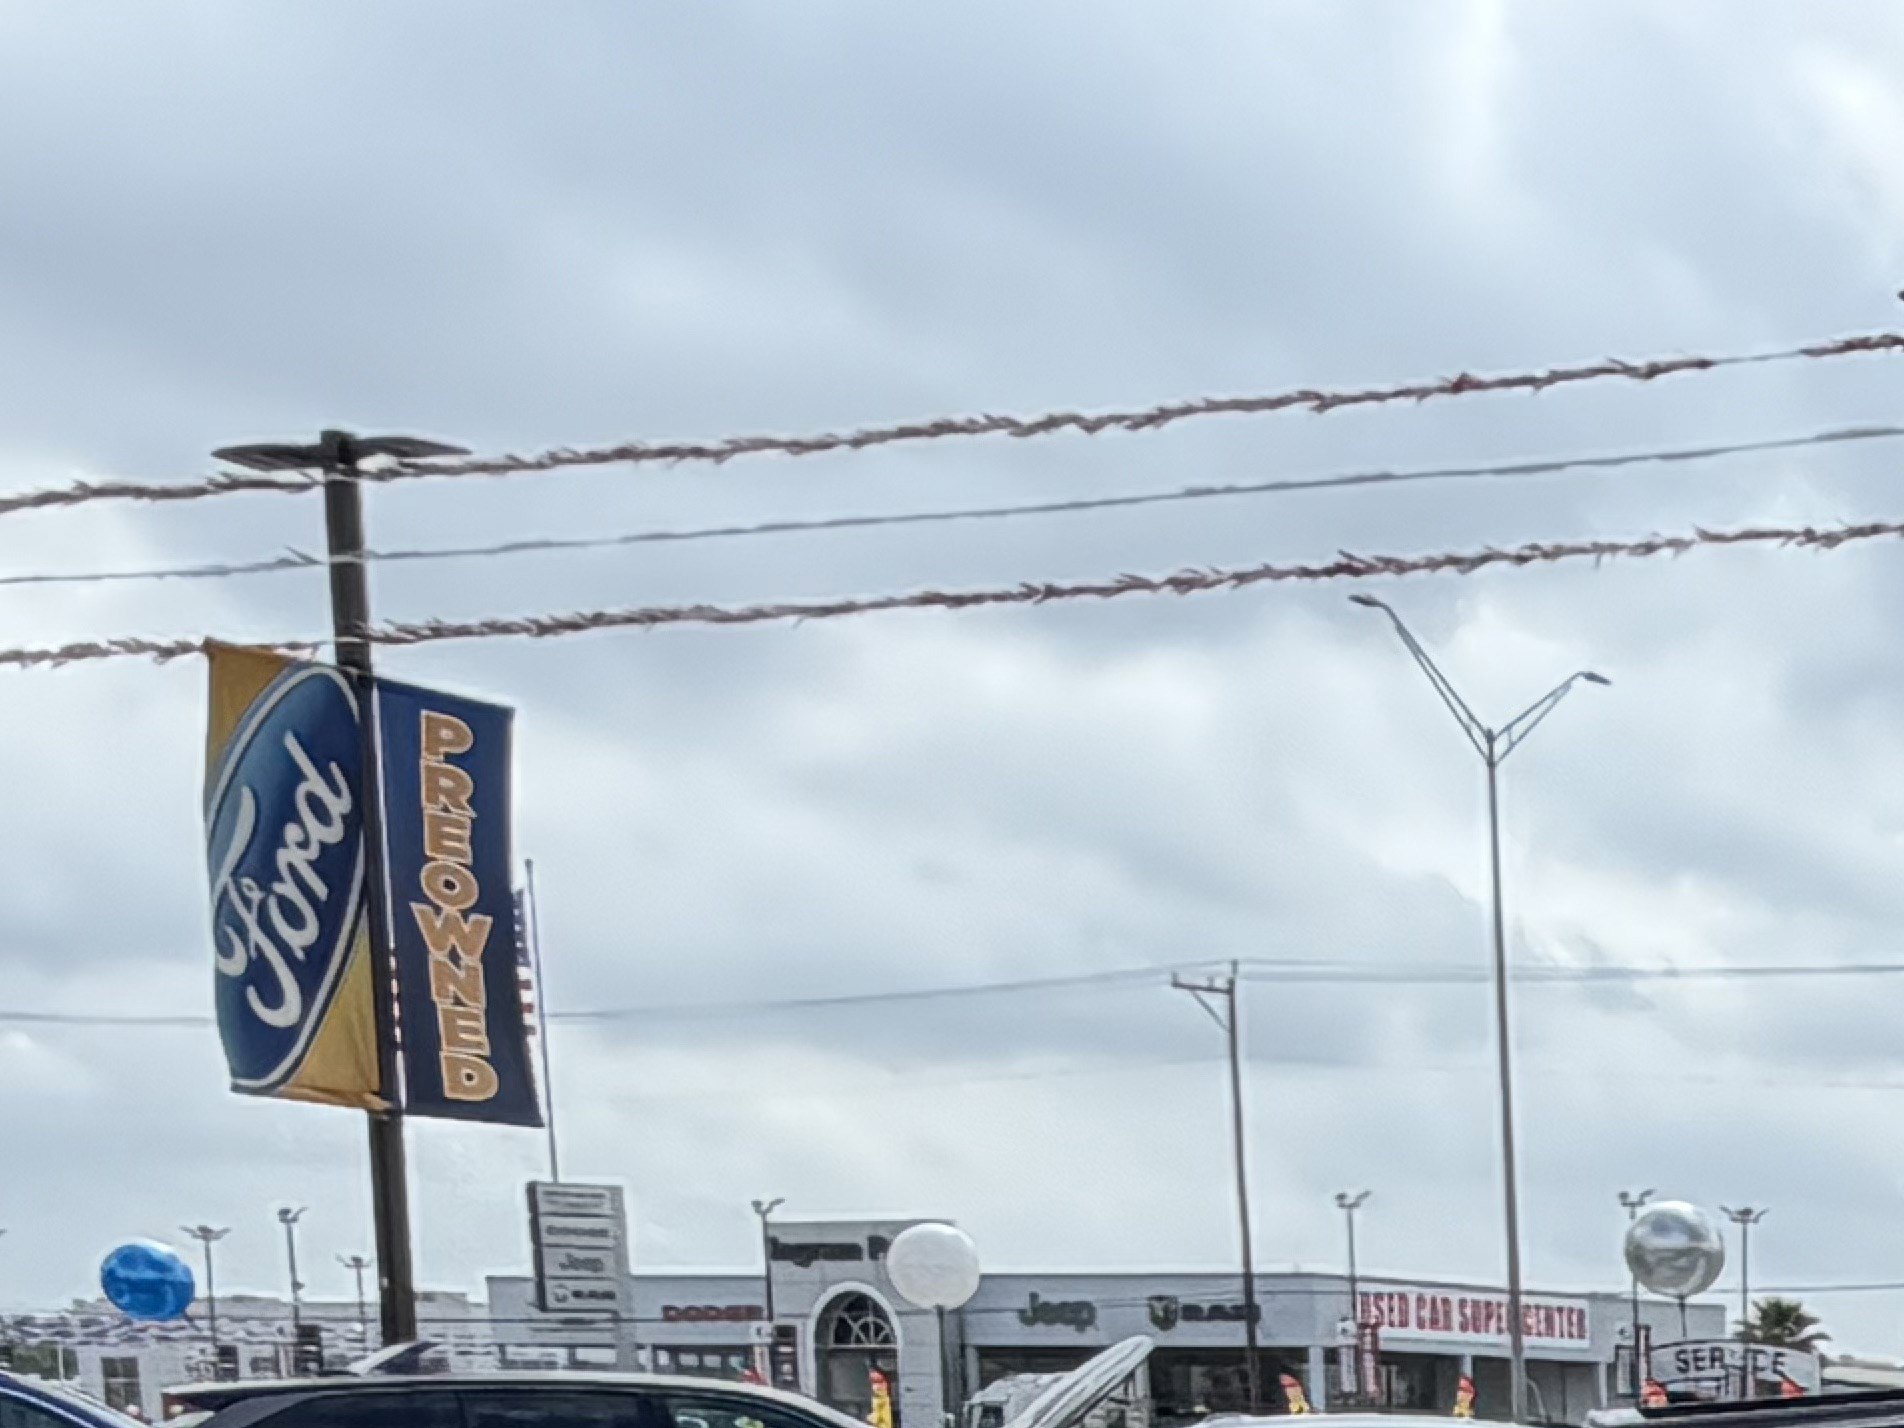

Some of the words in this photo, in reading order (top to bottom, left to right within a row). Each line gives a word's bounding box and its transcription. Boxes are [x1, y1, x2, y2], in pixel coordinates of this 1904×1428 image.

[211, 731, 352, 1029] Ford
[409, 710, 499, 1101] PREOWNED
[1017, 1291, 1098, 1333] Jeep
[1358, 1291, 1410, 1328] USED
[1416, 1292, 1453, 1332] CAR
[1458, 1297, 1514, 1336] SUPE
